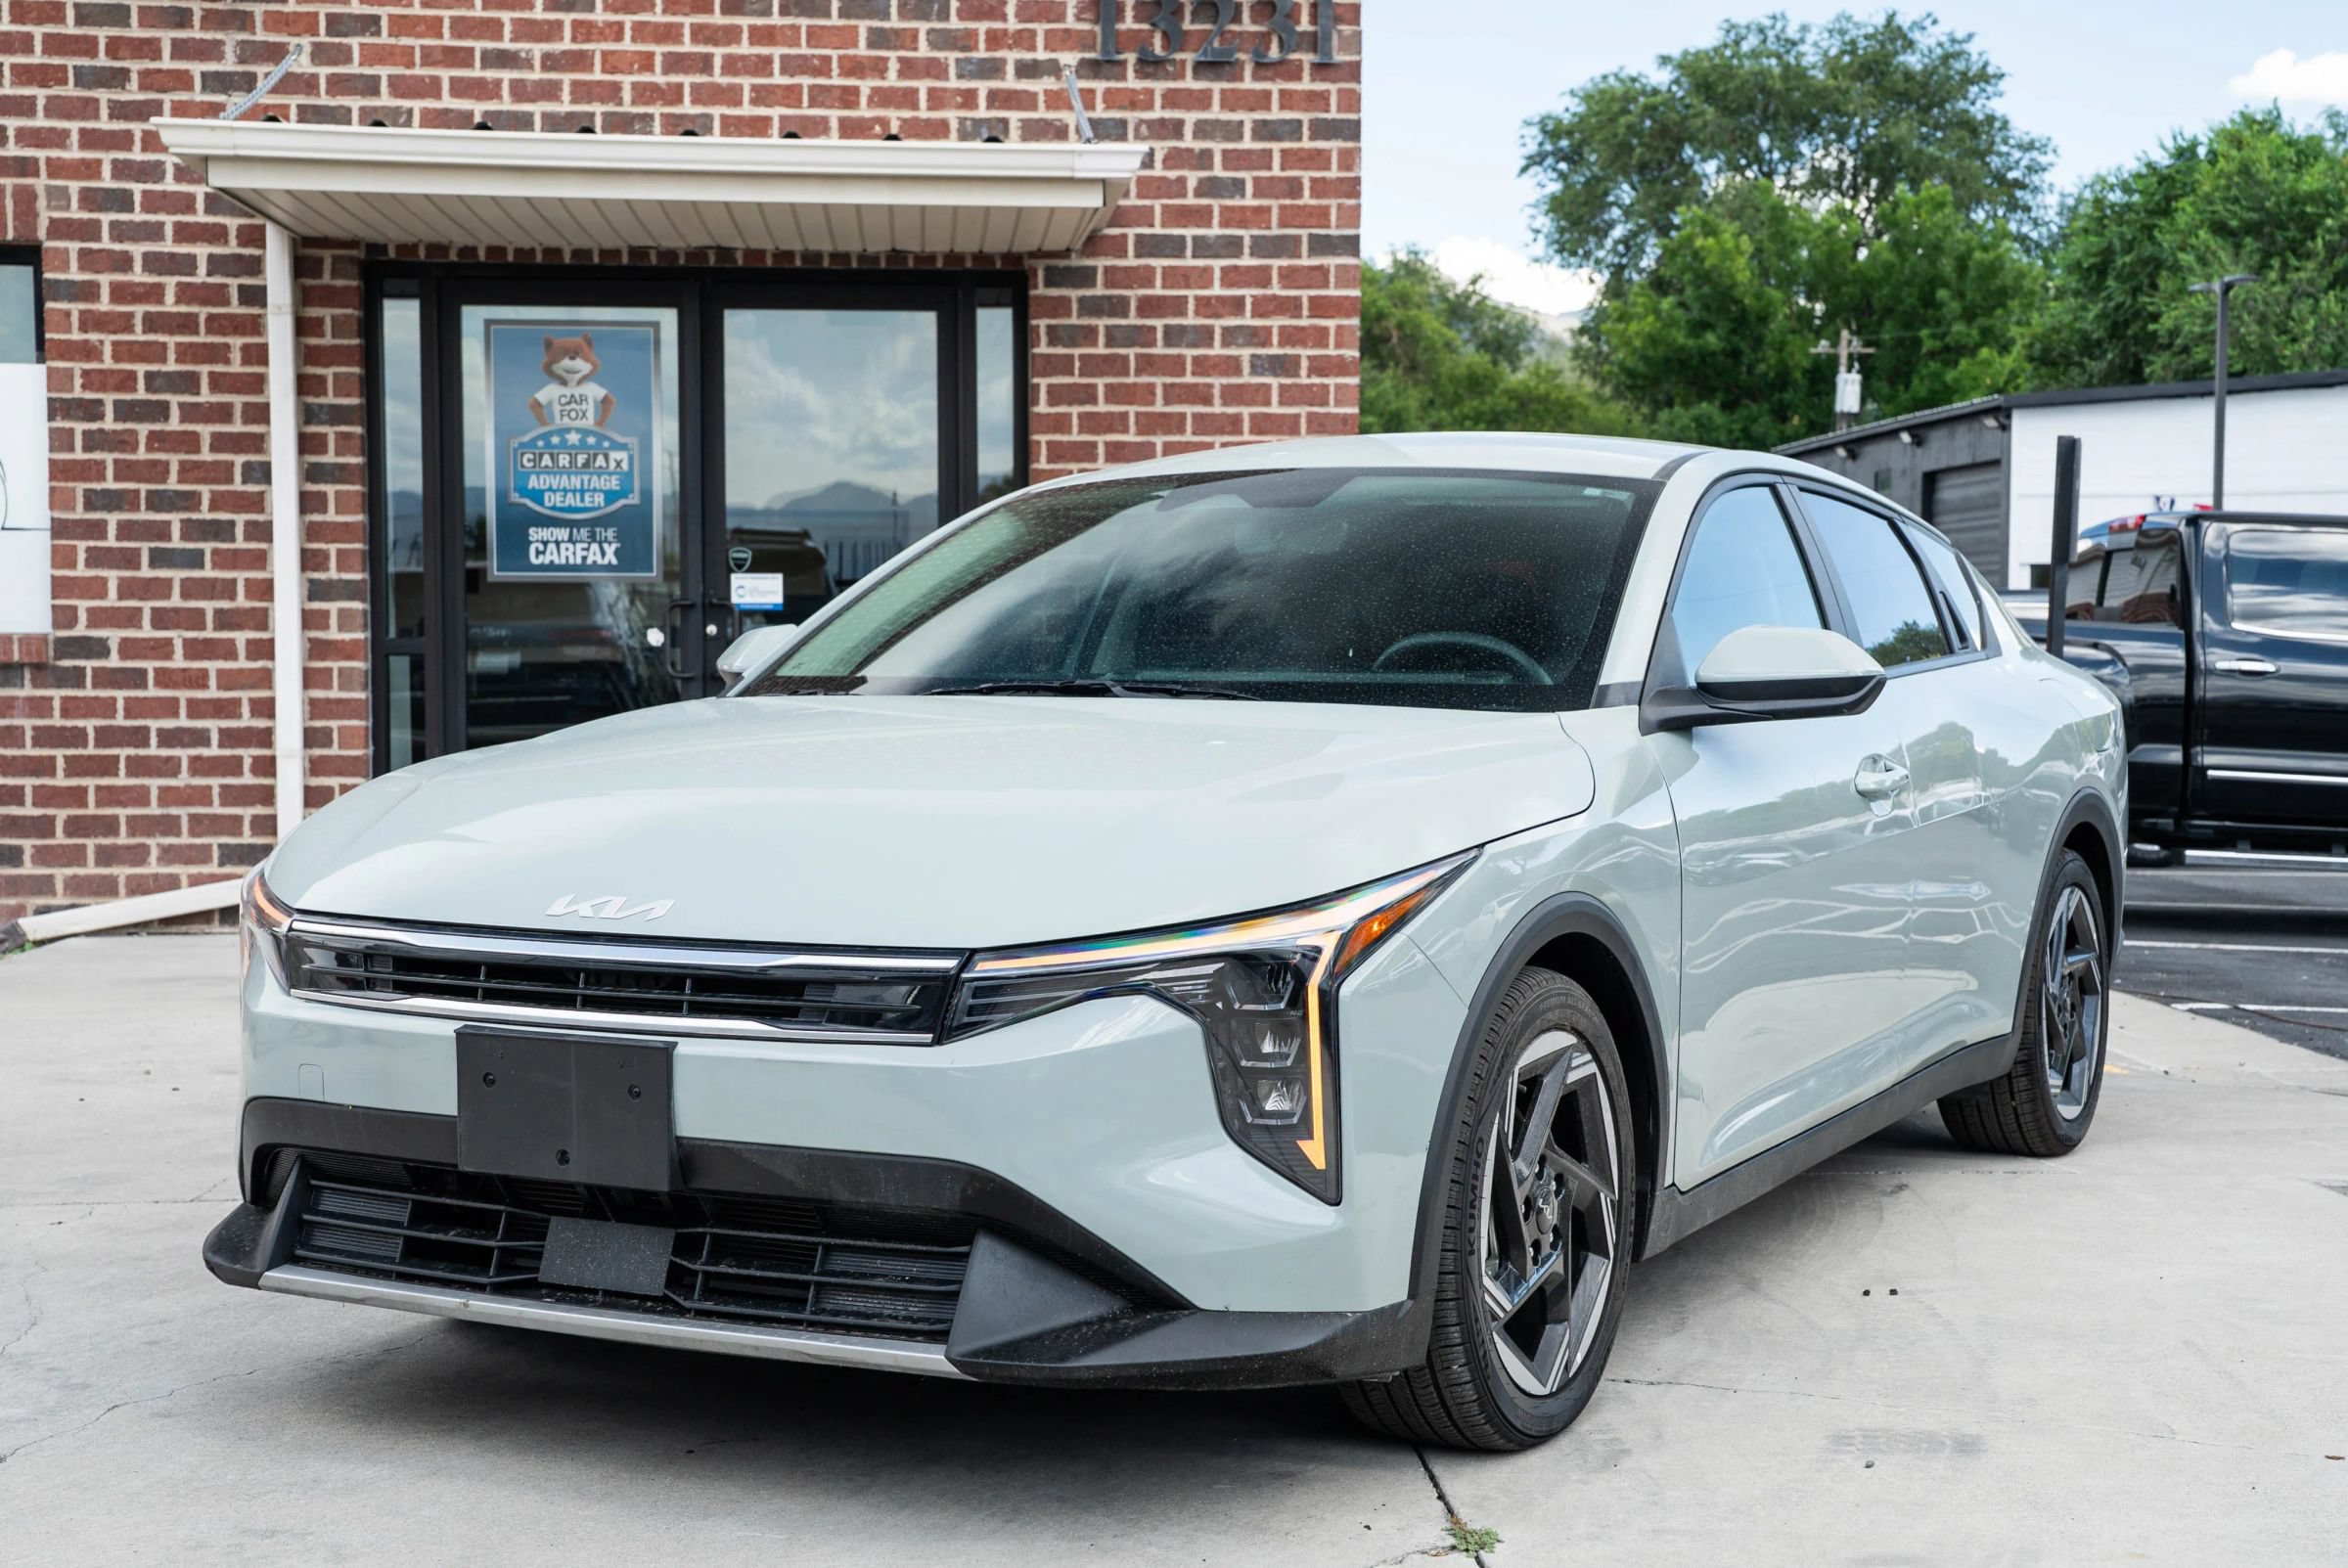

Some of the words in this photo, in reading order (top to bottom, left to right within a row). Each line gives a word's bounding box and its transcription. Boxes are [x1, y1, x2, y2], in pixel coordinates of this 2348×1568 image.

[1097, 0, 1339, 63] 13231
[558, 393, 589, 407] CAR
[560, 408, 589, 422] FOX
[520, 452, 625, 470] CARFAX
[528, 474, 620, 489] ADVANTAGE
[544, 492, 605, 507] DEALER
[528, 527, 570, 542] SHOW
[572, 528, 591, 542] ME
[595, 528, 617, 542] THE
[529, 543, 619, 565] CARFAX
[545, 892, 675, 921] KIA
[1468, 1136, 1485, 1257] KUMHO
